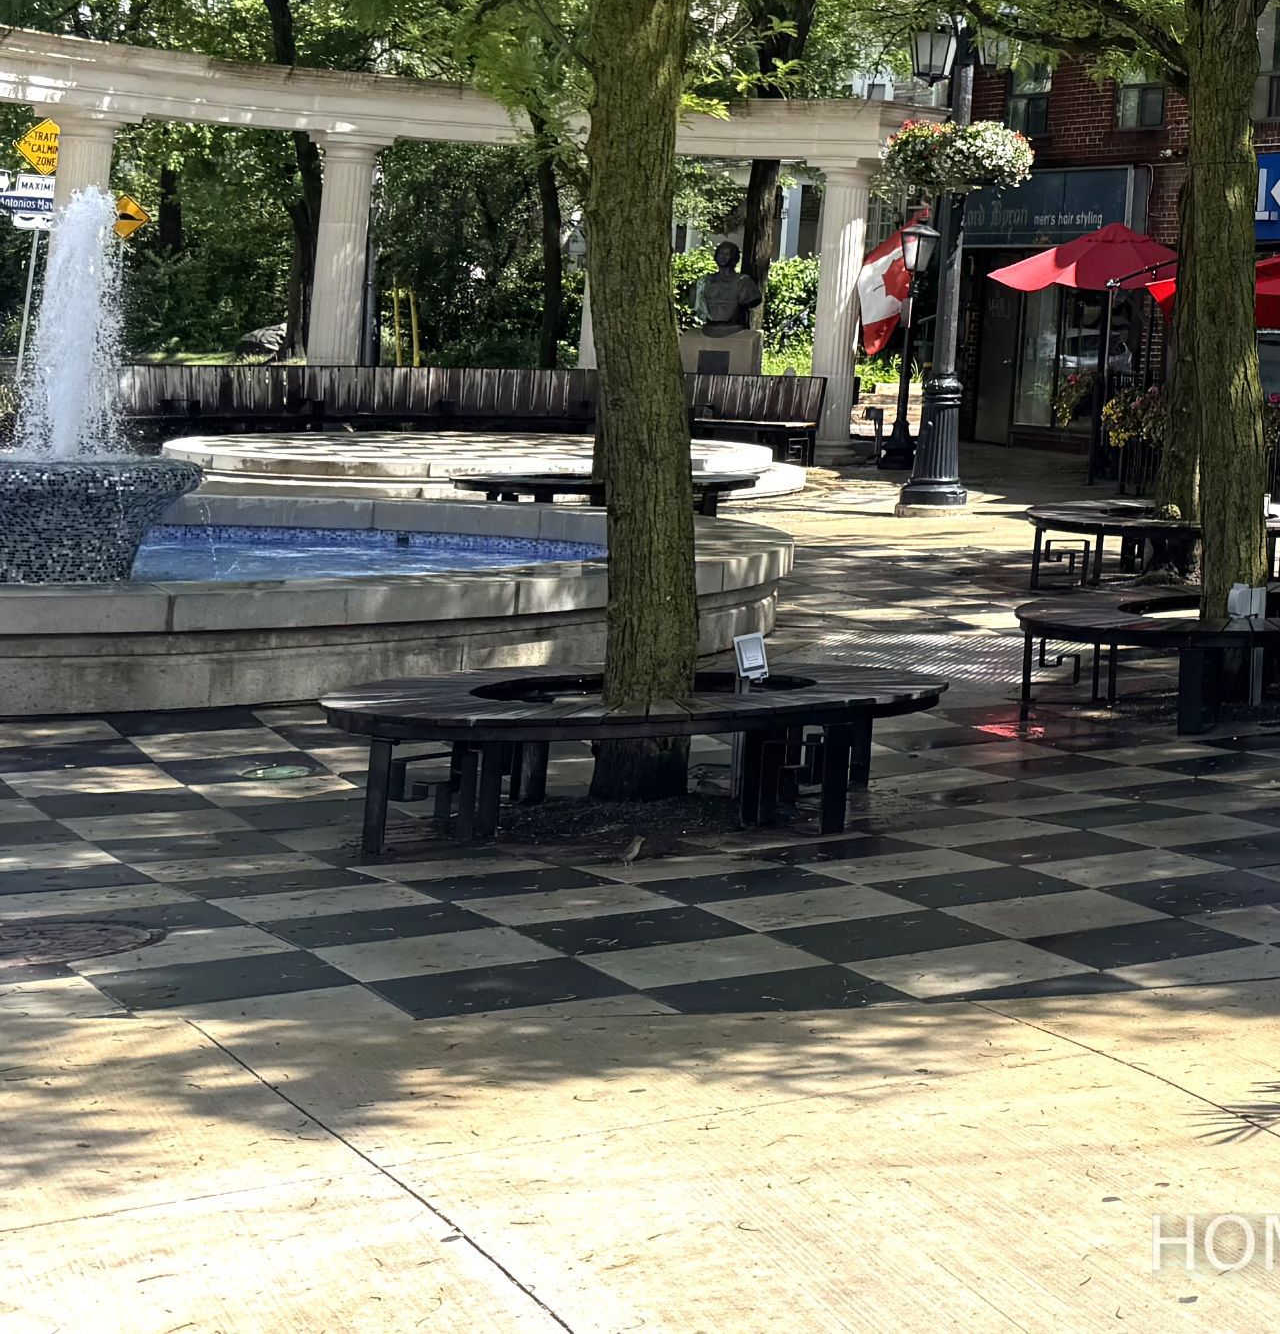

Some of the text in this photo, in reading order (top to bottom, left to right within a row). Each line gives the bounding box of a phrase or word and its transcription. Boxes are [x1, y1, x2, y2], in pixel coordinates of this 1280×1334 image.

[31, 144, 59, 154] CALMIN
[37, 156, 56, 167] ZONE
[1058, 212, 1073, 225] hair
[1076, 211, 1103, 229] styling
